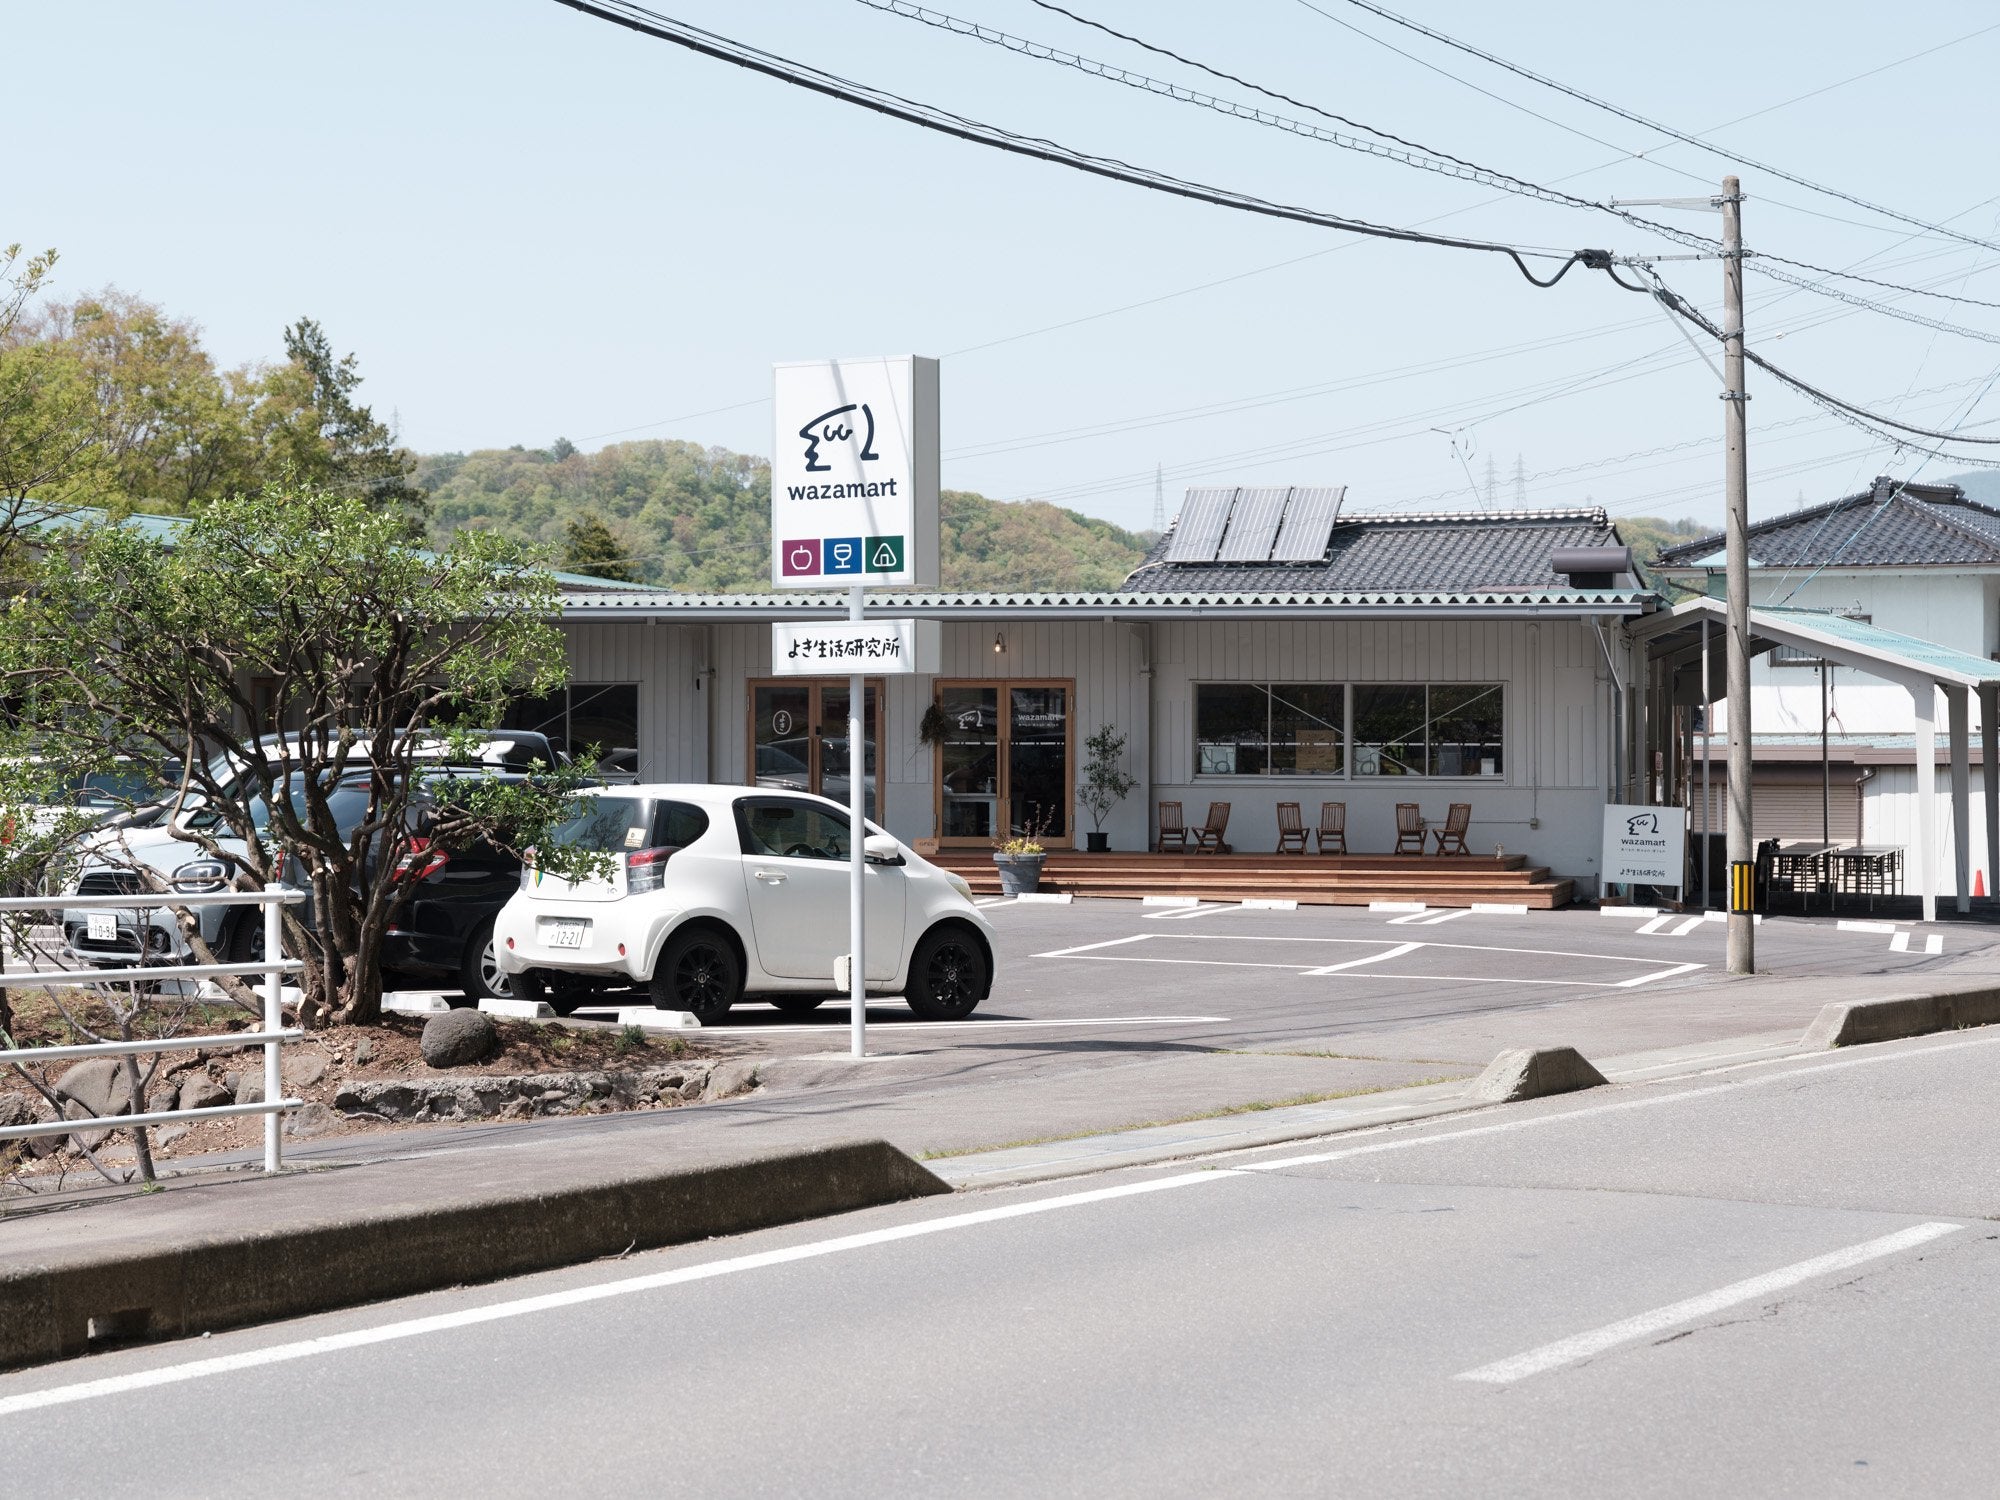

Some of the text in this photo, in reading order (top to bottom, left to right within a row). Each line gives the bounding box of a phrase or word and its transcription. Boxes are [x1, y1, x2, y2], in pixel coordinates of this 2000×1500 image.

[787, 477, 897, 501] wazamart
[788, 636, 900, 659] よき生活研究所
[1018, 714, 1060, 722] wazamart
